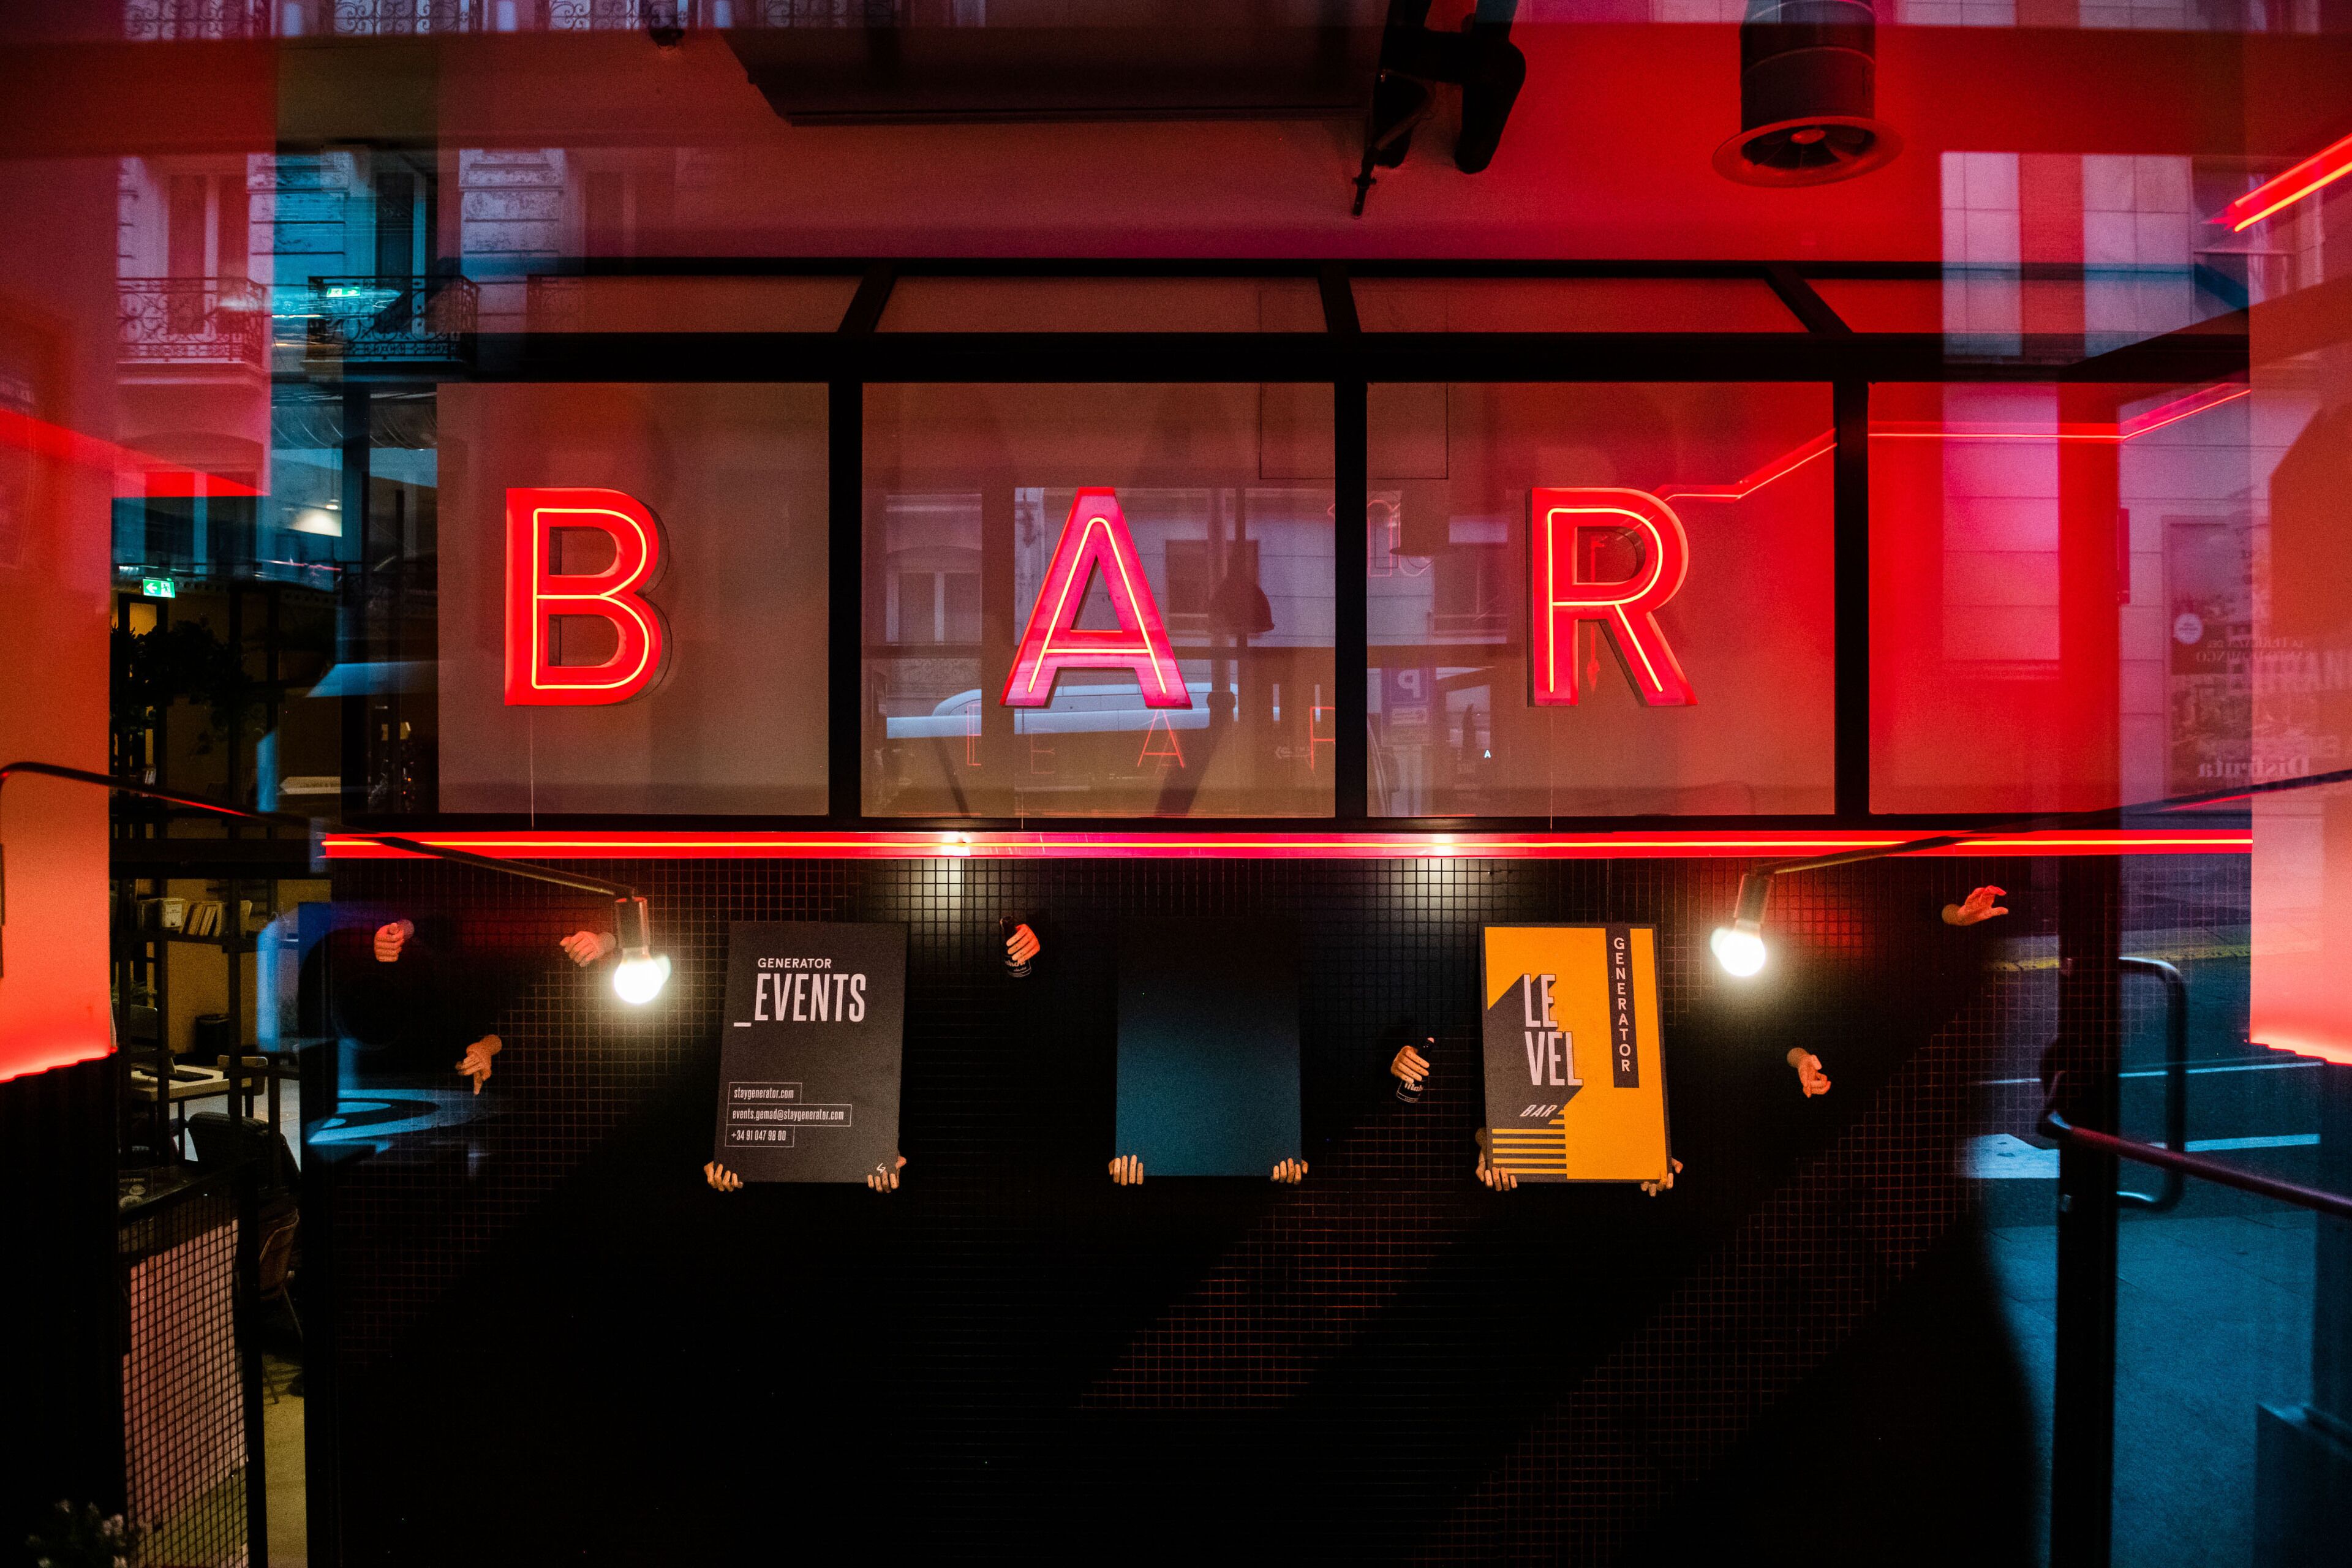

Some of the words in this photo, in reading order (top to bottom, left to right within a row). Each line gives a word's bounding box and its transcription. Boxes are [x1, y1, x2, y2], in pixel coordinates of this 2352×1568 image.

[505, 486, 1698, 708] BAR
[757, 957, 832, 968] GENERATOR
[1523, 974, 1559, 1027] LE
[1613, 937, 1631, 1072] GENERATOR
[1525, 1031, 1583, 1086] VEL
[734, 1087, 794, 1100] staygenerator.com
[733, 1108, 844, 1121] events.gemad@staygenerator.com
[1520, 1104, 1558, 1117] BAR
[731, 1130, 744, 1140] +34
[746, 1130, 753, 1140] 91
[755, 1130, 766, 1140] 047
[768, 1130, 776, 1140] 98
[778, 1130, 786, 1141] 00
